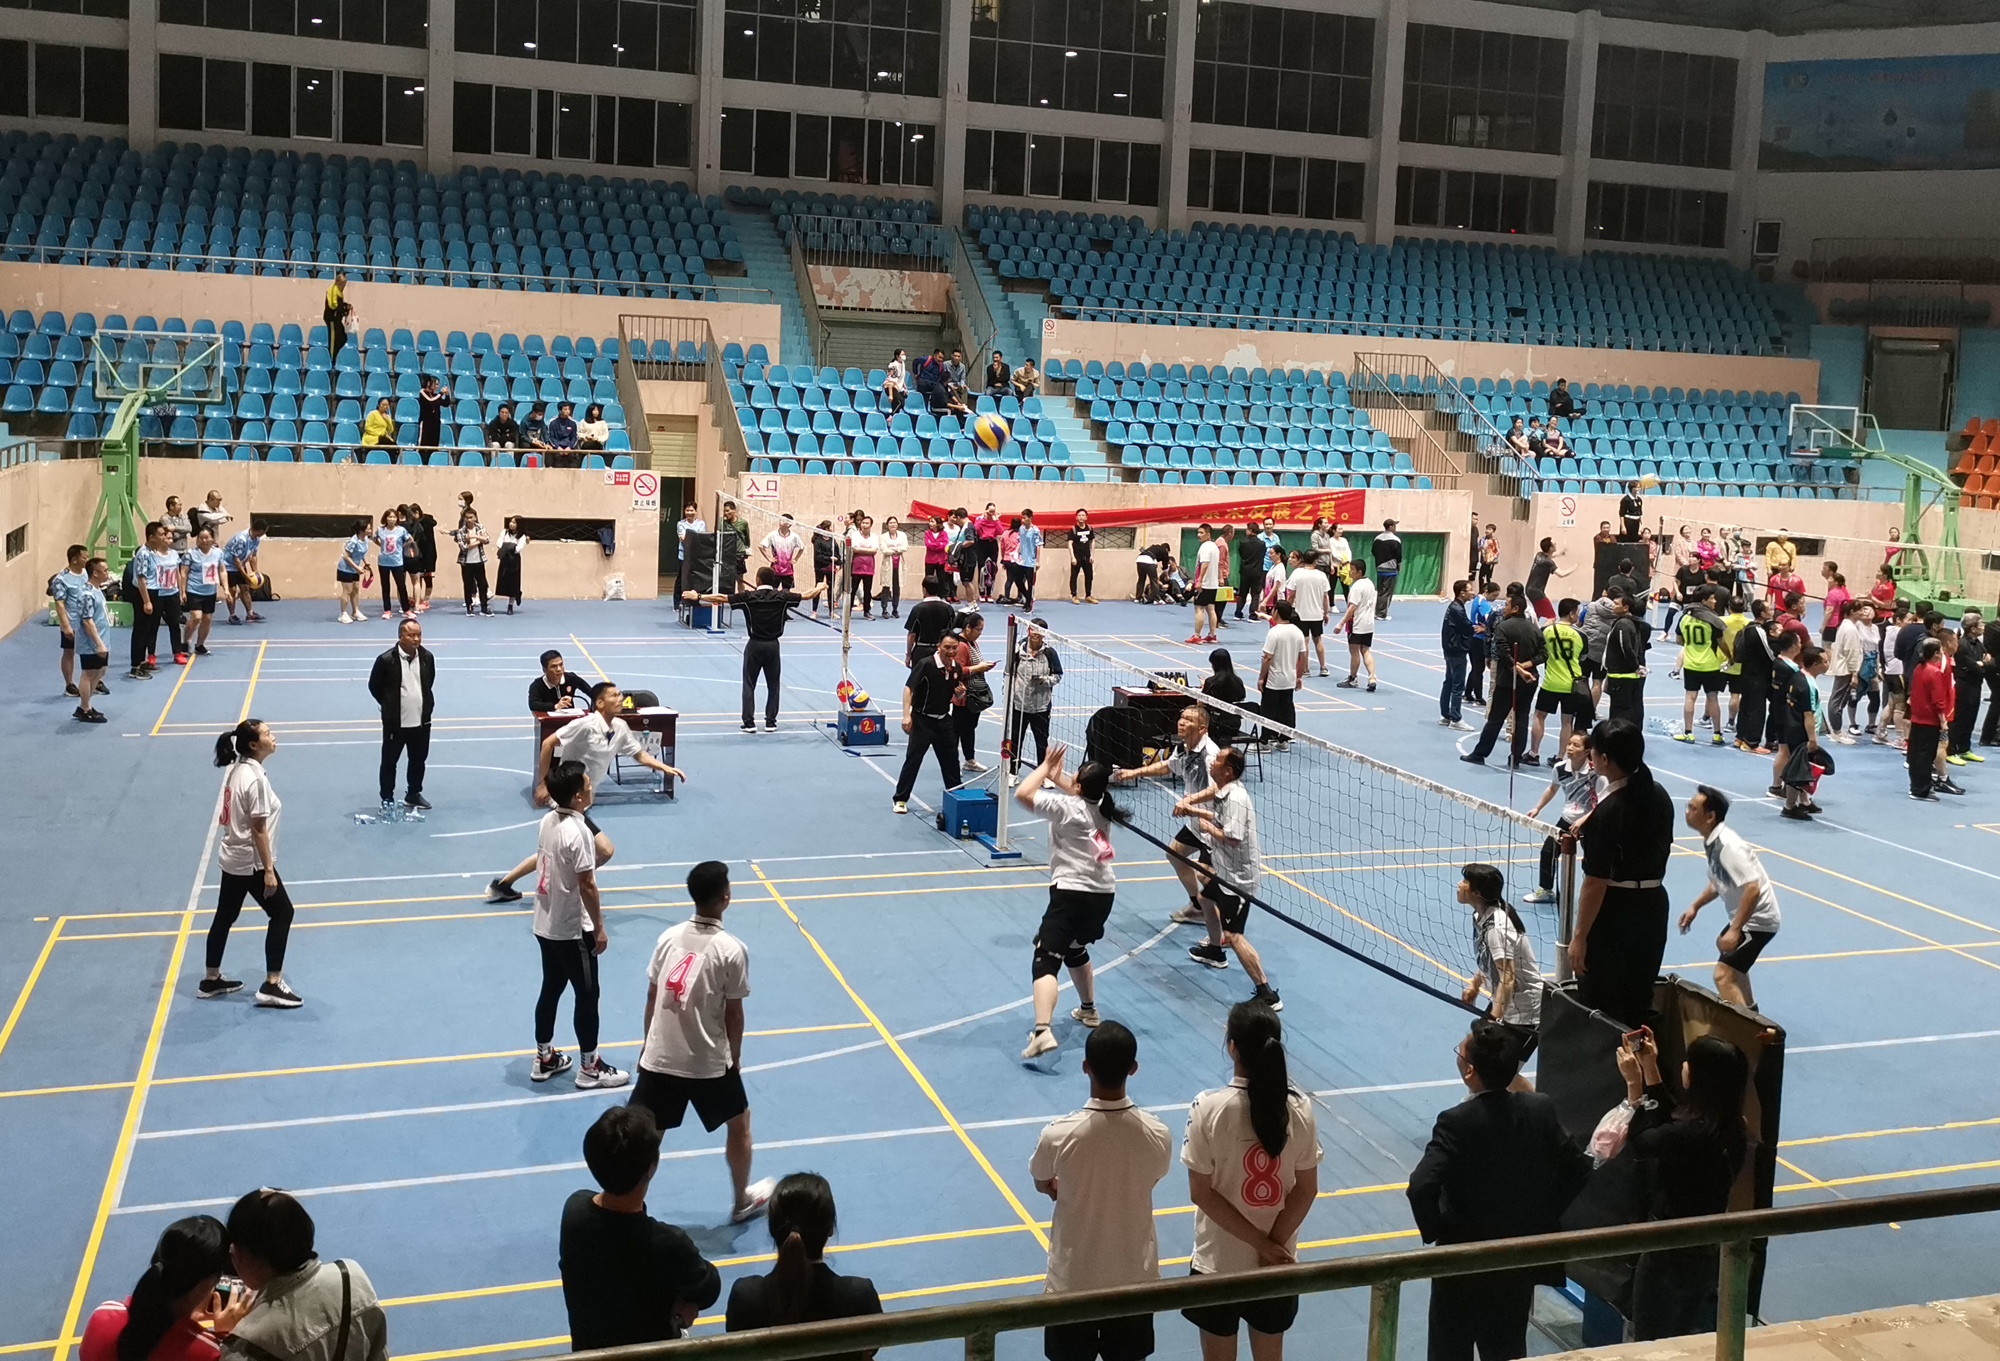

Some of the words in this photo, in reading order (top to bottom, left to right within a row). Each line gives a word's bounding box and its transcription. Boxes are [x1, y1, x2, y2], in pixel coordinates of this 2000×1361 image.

[746, 478, 777, 492] 入口
[205, 564, 216, 581] 4
[1684, 625, 1705, 645] 10
[622, 696, 634, 709] 4
[863, 720, 872, 731] 2
[665, 952, 697, 1004] 4
[1241, 1142, 1283, 1208] 8
